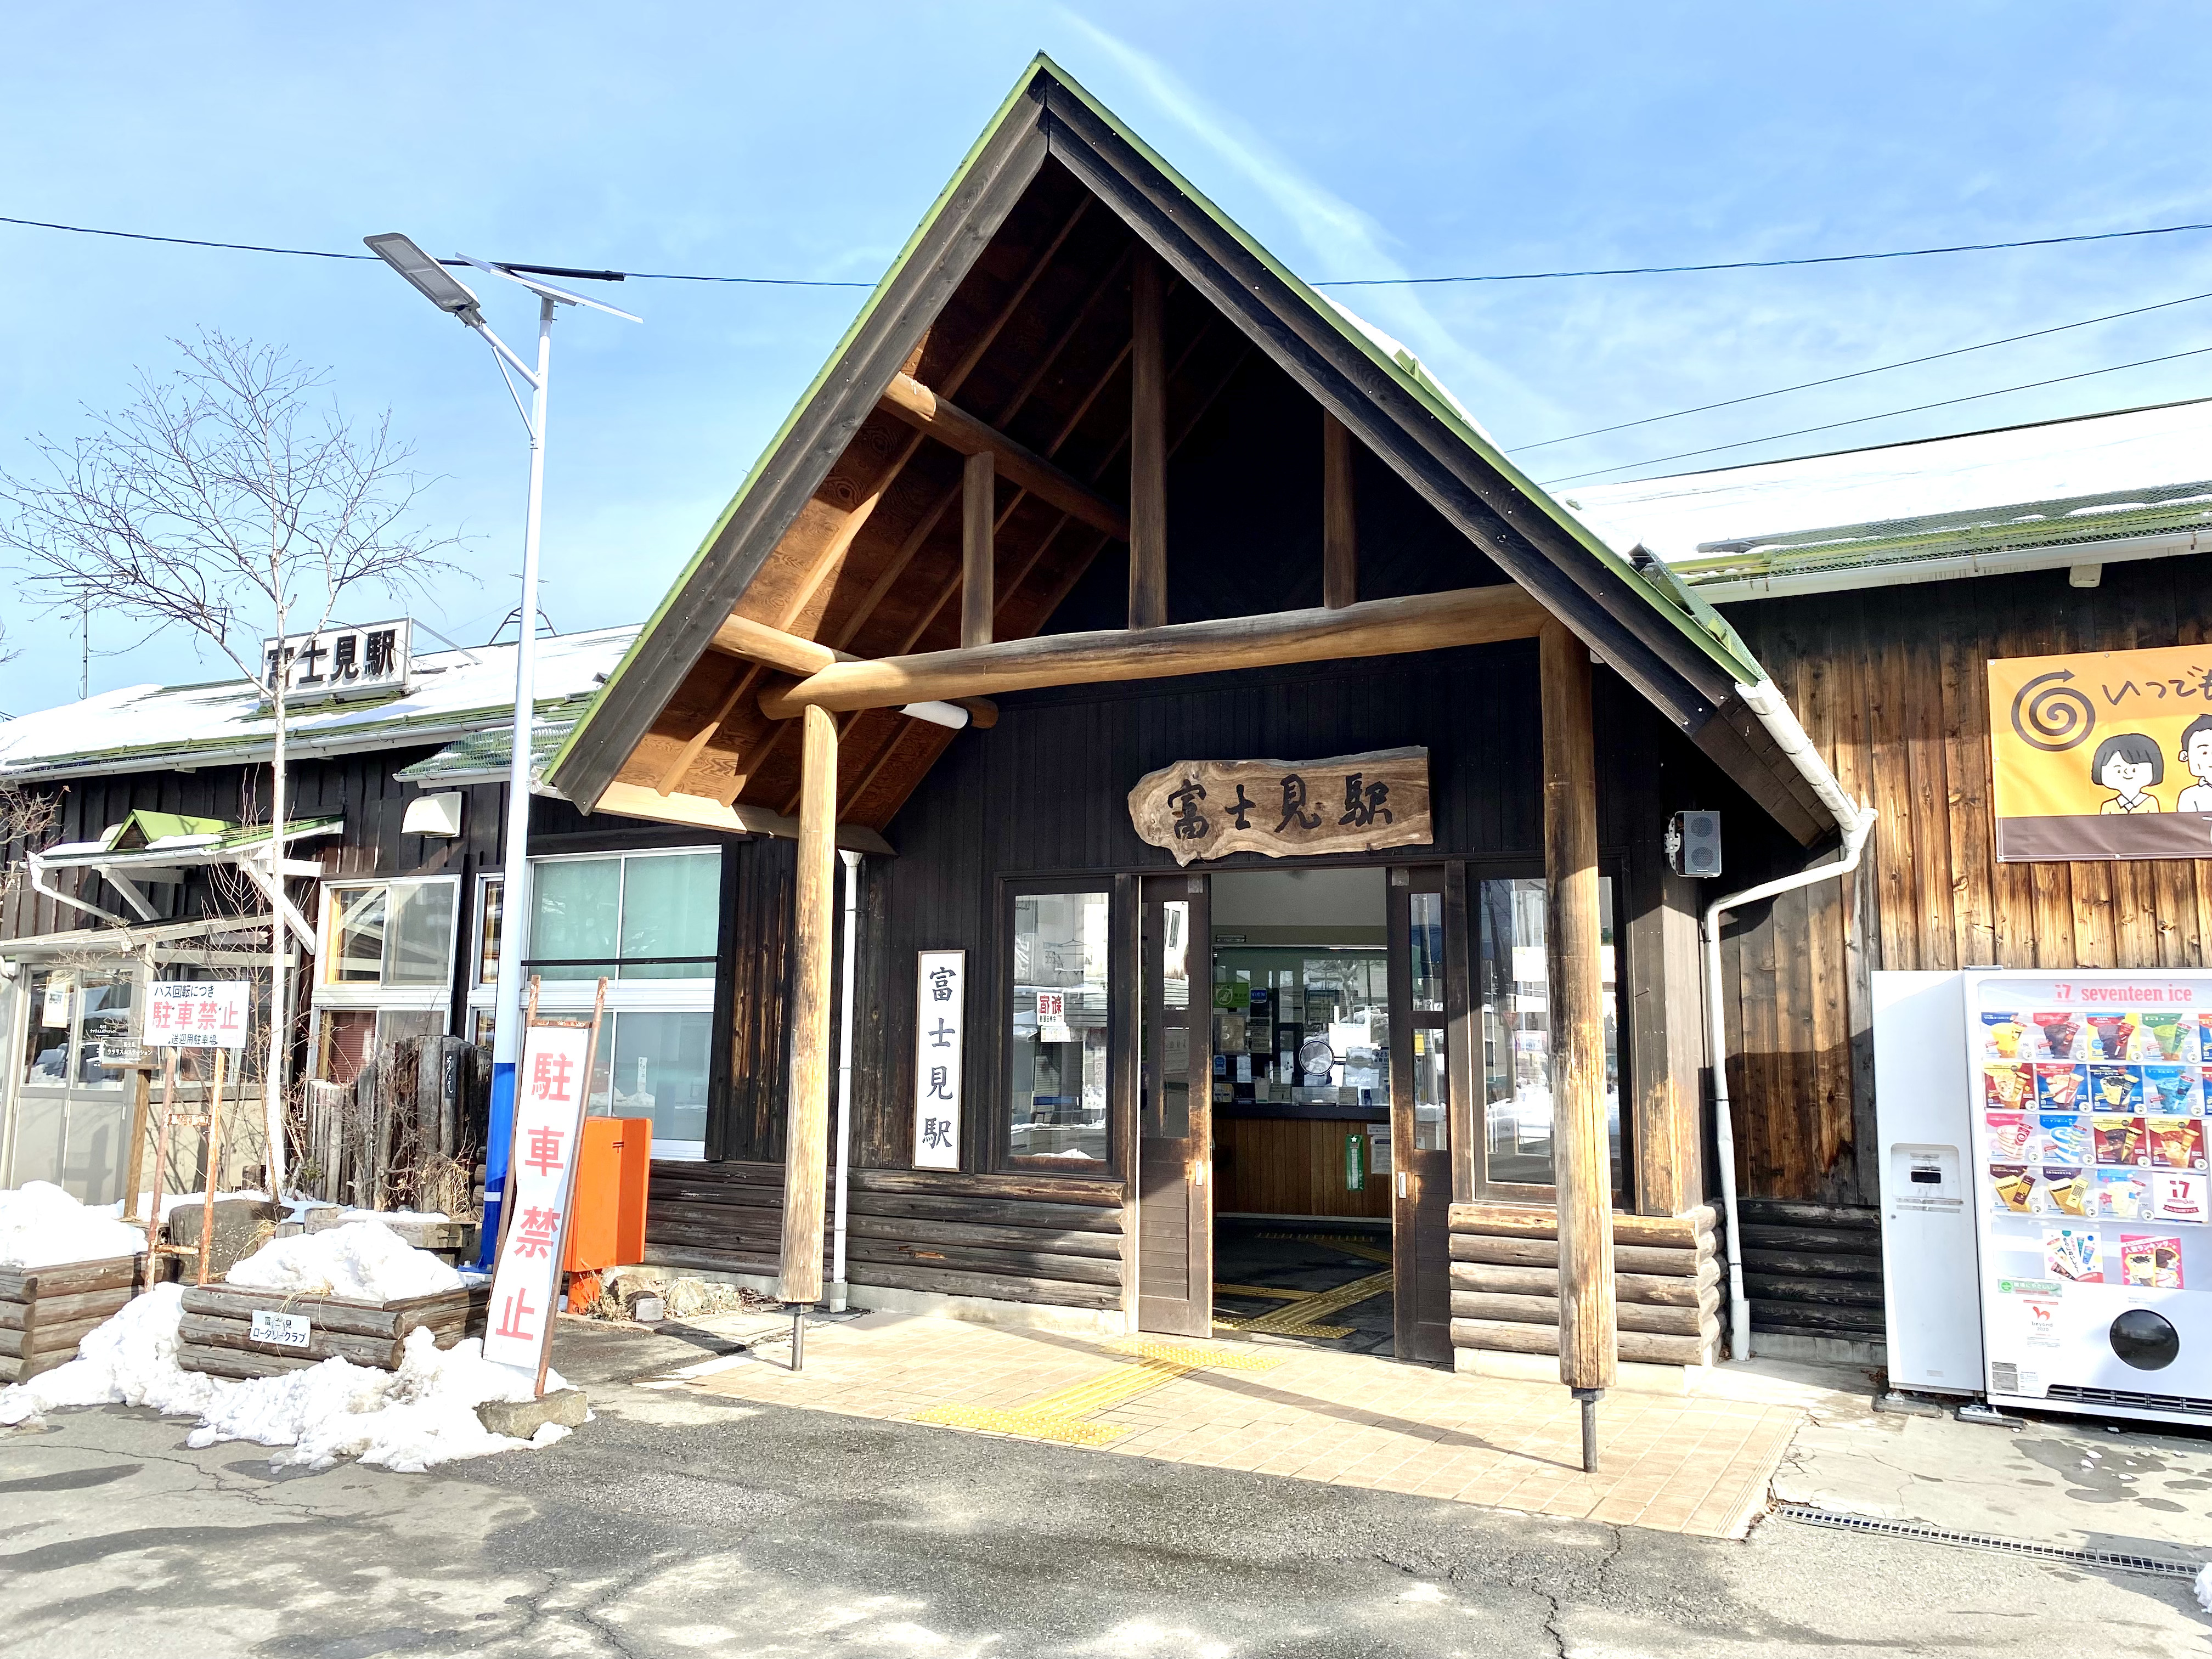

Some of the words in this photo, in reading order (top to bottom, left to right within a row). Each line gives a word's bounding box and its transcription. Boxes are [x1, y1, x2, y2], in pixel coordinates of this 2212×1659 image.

[267, 629, 396, 690] 富士見駅
[1167, 772, 1393, 839] 富士見駅
[154, 985, 215, 998] バス回転につき
[2082, 986, 2164, 1001] seventeen
[2169, 984, 2192, 1002] ice
[152, 1001, 239, 1030] 駐車禁止
[171, 1034, 218, 1045] 送迎用駐車場
[922, 967, 956, 1149] 富士見駅
[495, 1052, 573, 1340] 駐車禁止
[264, 1317, 292, 1328] 富士見
[253, 1328, 308, 1343] ロータリークラブ
